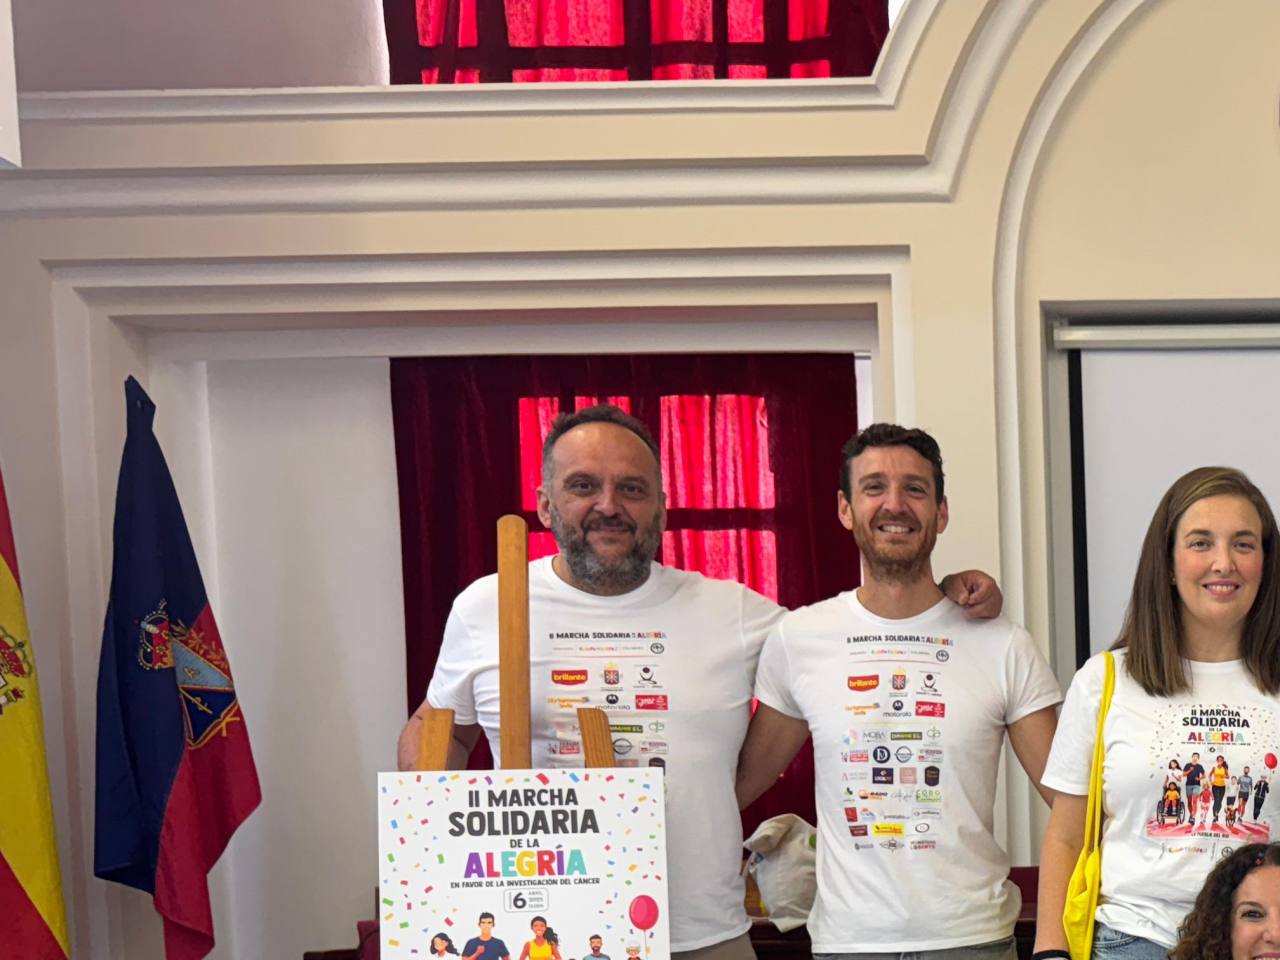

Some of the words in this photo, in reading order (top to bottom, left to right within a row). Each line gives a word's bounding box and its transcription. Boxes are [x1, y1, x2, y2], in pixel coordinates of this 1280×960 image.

[1199, 708, 1241, 717] MARCHA
[1182, 716, 1250, 728] SOLIDARIA
[468, 790, 480, 808] II
[488, 788, 579, 807] MARCHA
[448, 809, 600, 837] SOLIDARIA
[510, 839, 523, 848] DE
[527, 838, 540, 848] LA
[464, 844, 587, 878] ALEGRÍA
[560, 878, 571, 886] DEL
[513, 892, 527, 909] 6
